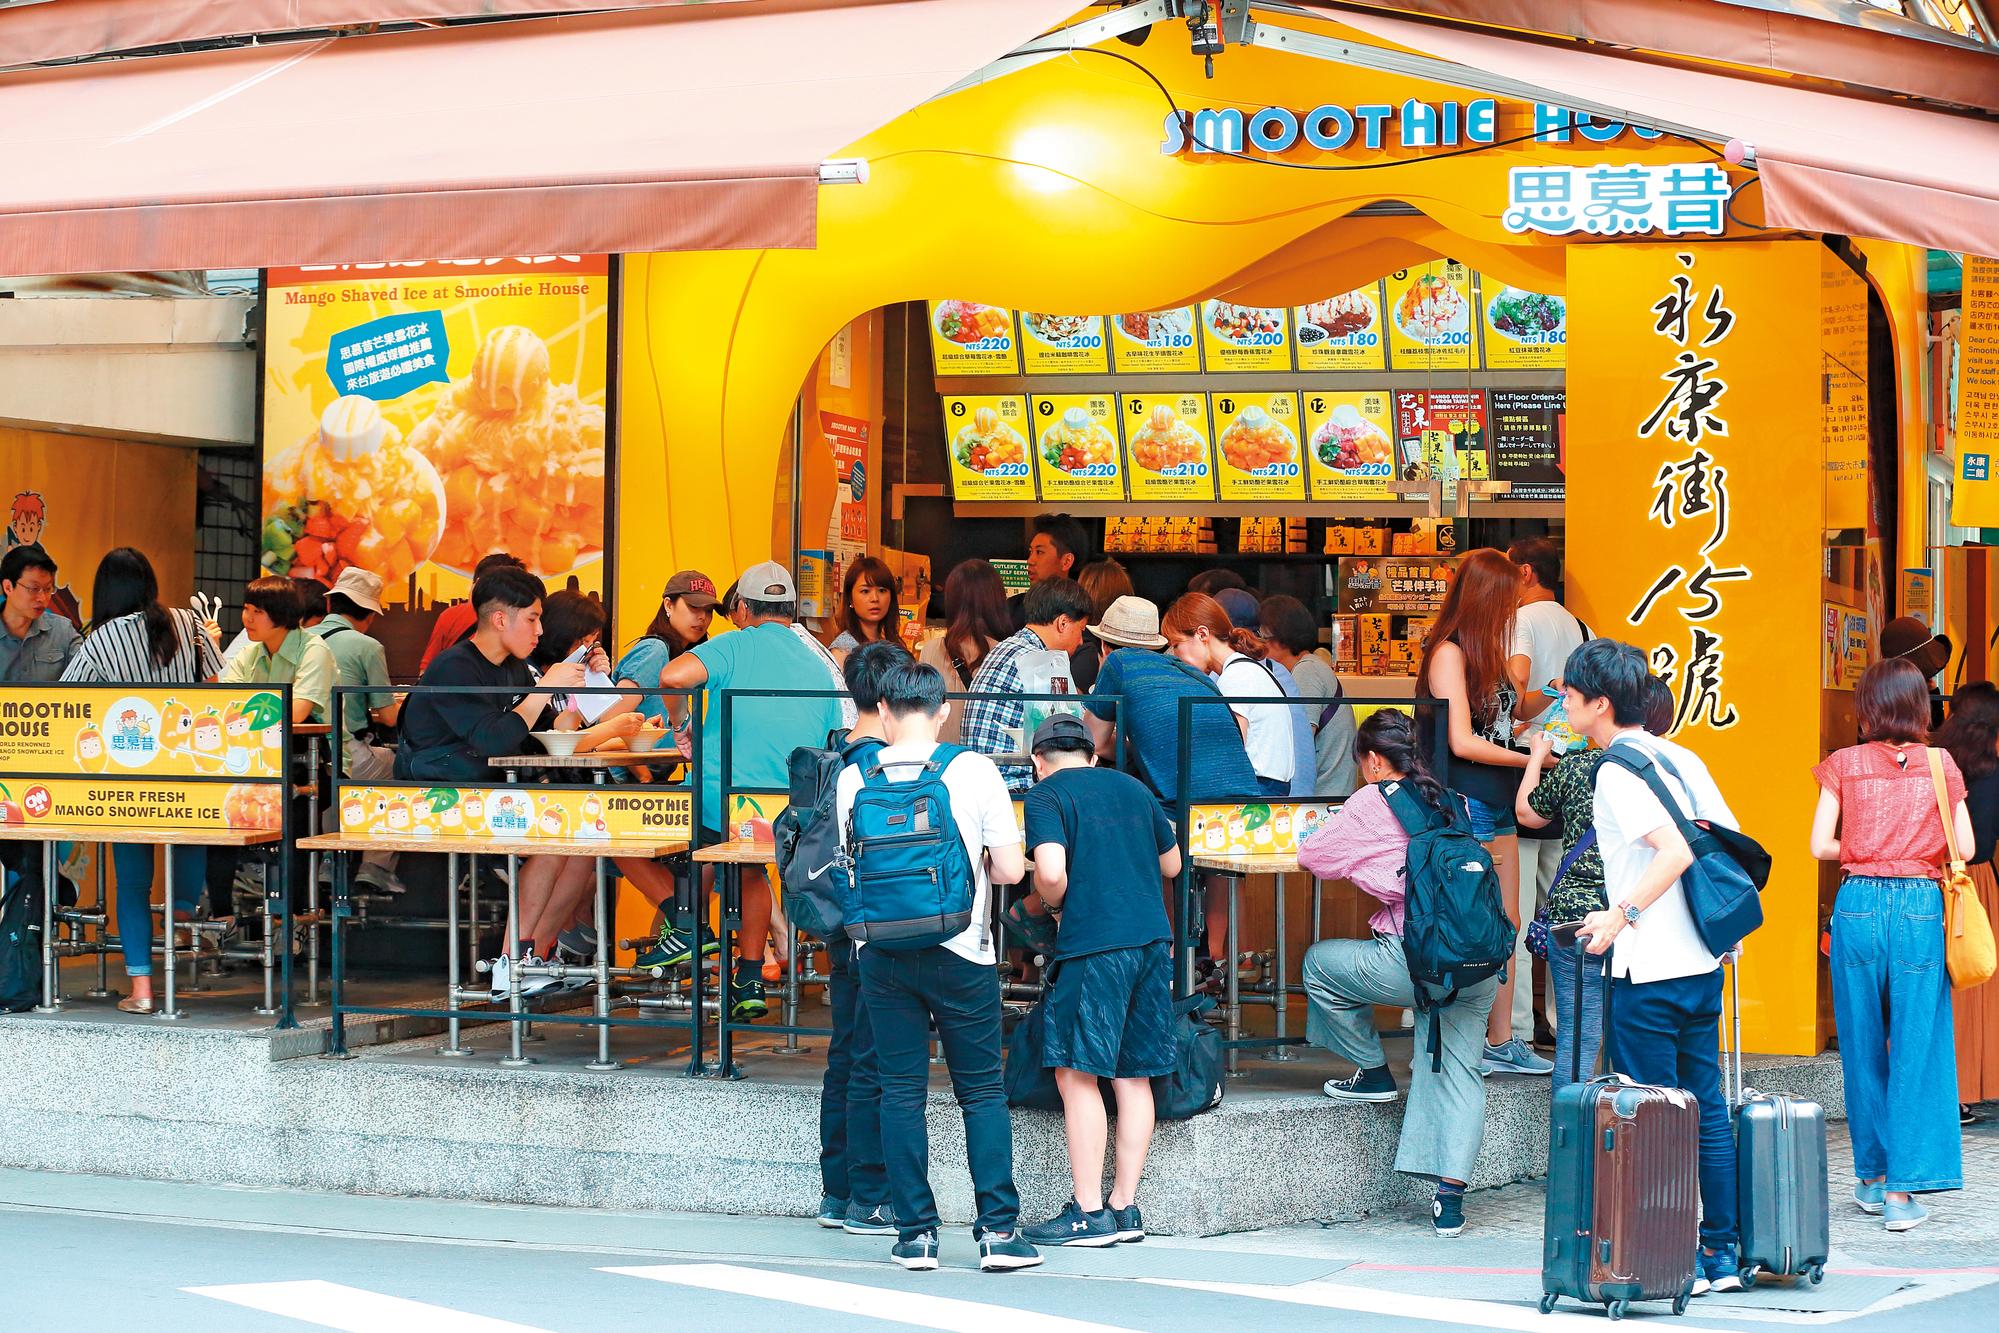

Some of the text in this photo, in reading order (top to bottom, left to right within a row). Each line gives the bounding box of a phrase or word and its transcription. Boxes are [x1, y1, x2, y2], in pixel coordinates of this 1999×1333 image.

[1162, 98, 1495, 155] SMOOTHIE
[1505, 166, 1729, 233] 思慕昔
[285, 281, 590, 307] Mango Shaved Ice at Smoothie House
[965, 337, 1010, 350] NT$220
[1056, 335, 1101, 348] NT$200
[1146, 334, 1193, 347] NT$180
[1237, 332, 1283, 346] NT$200
[1330, 333, 1378, 346] NT$180
[1508, 393, 1529, 401] Floor
[985, 463, 1029, 476] NT$220
[1072, 464, 1117, 476] NT$220
[1162, 463, 1207, 476] NT$210
[1252, 463, 1299, 476] NT$210
[1345, 463, 1392, 476] NT$220
[0, 701, 92, 719] MOOTHIE
[88, 790, 186, 803] SUPER FRESH
[607, 797, 689, 812] SMOOTHIE
[54, 805, 220, 819] MANGO SNOWFLAKE ICE
[642, 812, 689, 826] HOUSE
